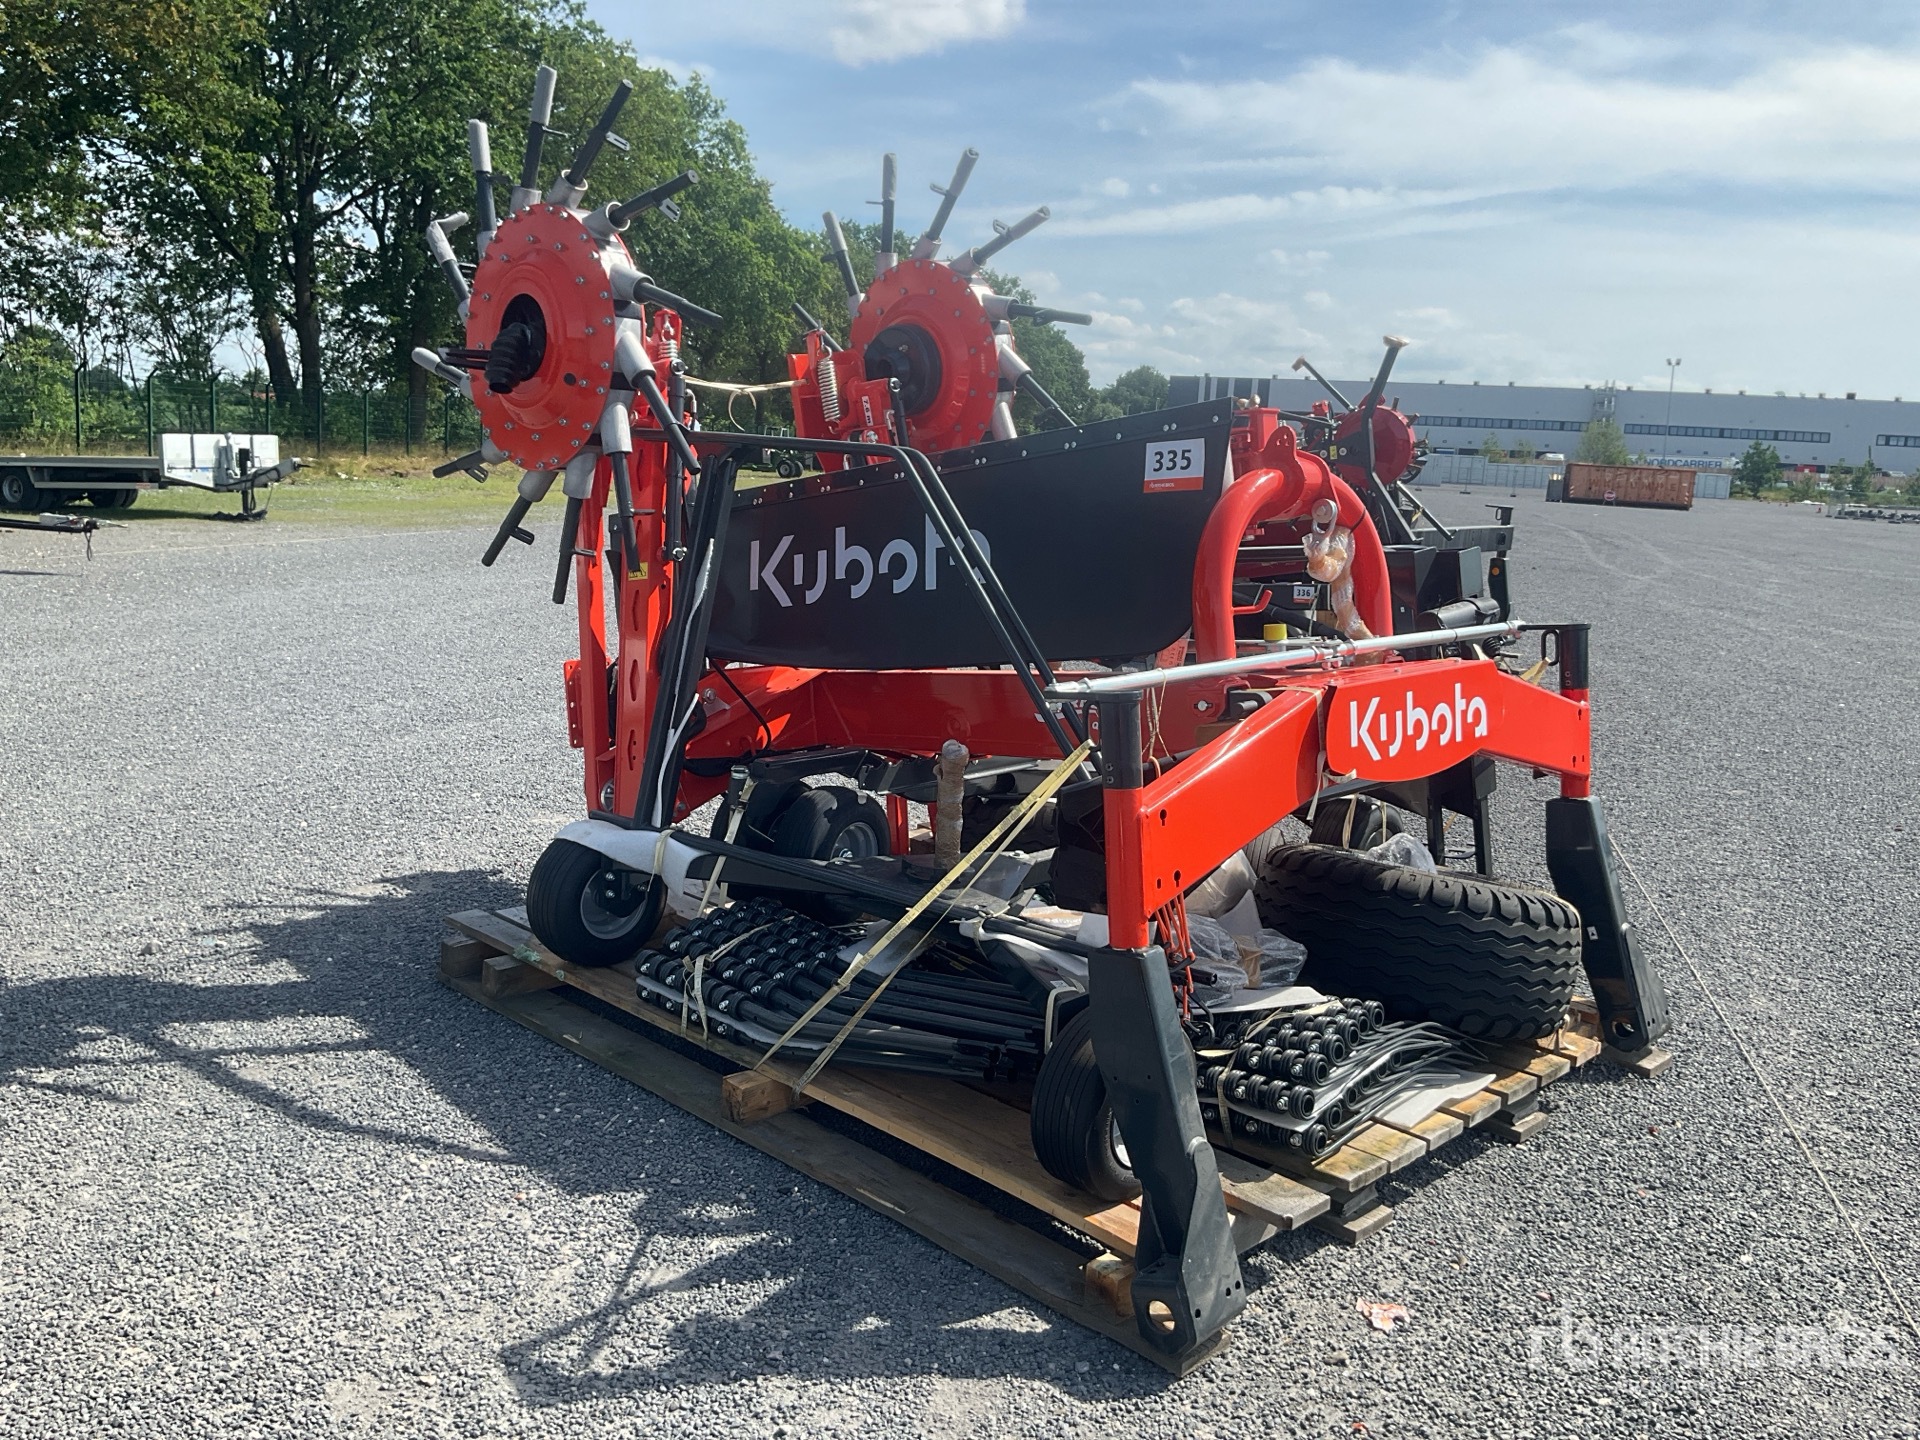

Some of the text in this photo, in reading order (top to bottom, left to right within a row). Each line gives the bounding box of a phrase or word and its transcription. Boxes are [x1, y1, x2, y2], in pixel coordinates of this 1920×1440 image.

[1153, 449, 1192, 472] 335
[1646, 458, 1723, 469] NORDCARRIER
[1296, 588, 1311, 597] 336
[1350, 682, 1488, 761] Kubota
